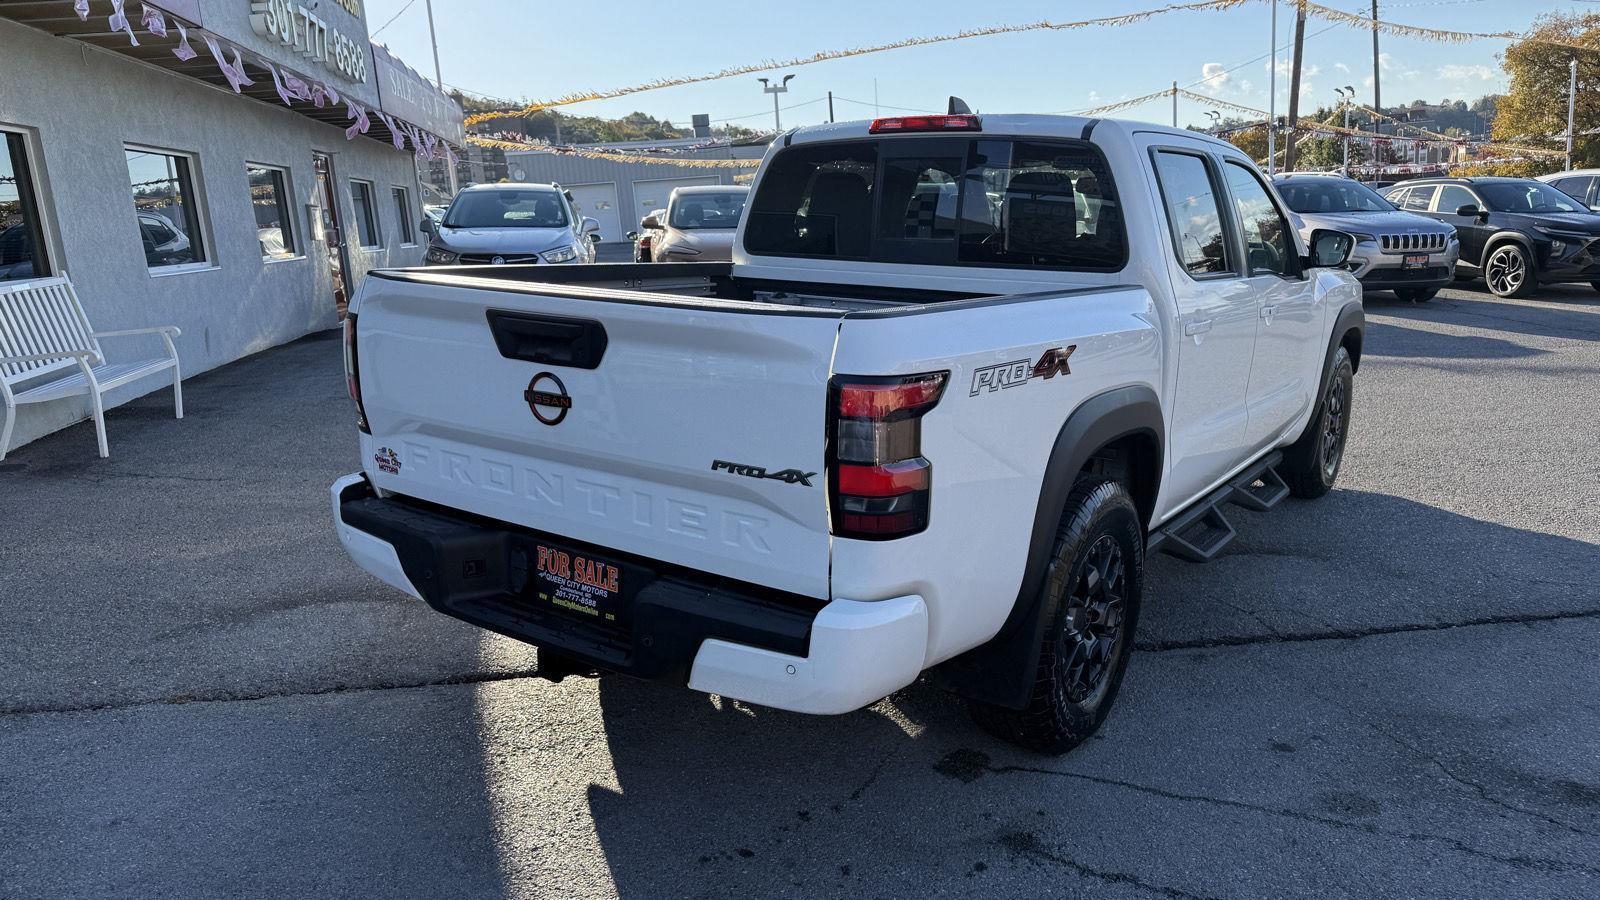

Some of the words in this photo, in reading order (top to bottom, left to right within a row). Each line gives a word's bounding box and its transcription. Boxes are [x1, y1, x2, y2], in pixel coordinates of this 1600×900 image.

[401, 440, 773, 555] FRONTIER
[537, 545, 571, 579] FOR
[574, 556, 619, 593] SALE
[546, 574, 567, 586] QUEEN
[566, 580, 581, 590] CITY
[581, 585, 608, 598] MOTORS
[555, 589, 597, 607] 301-777-8588
